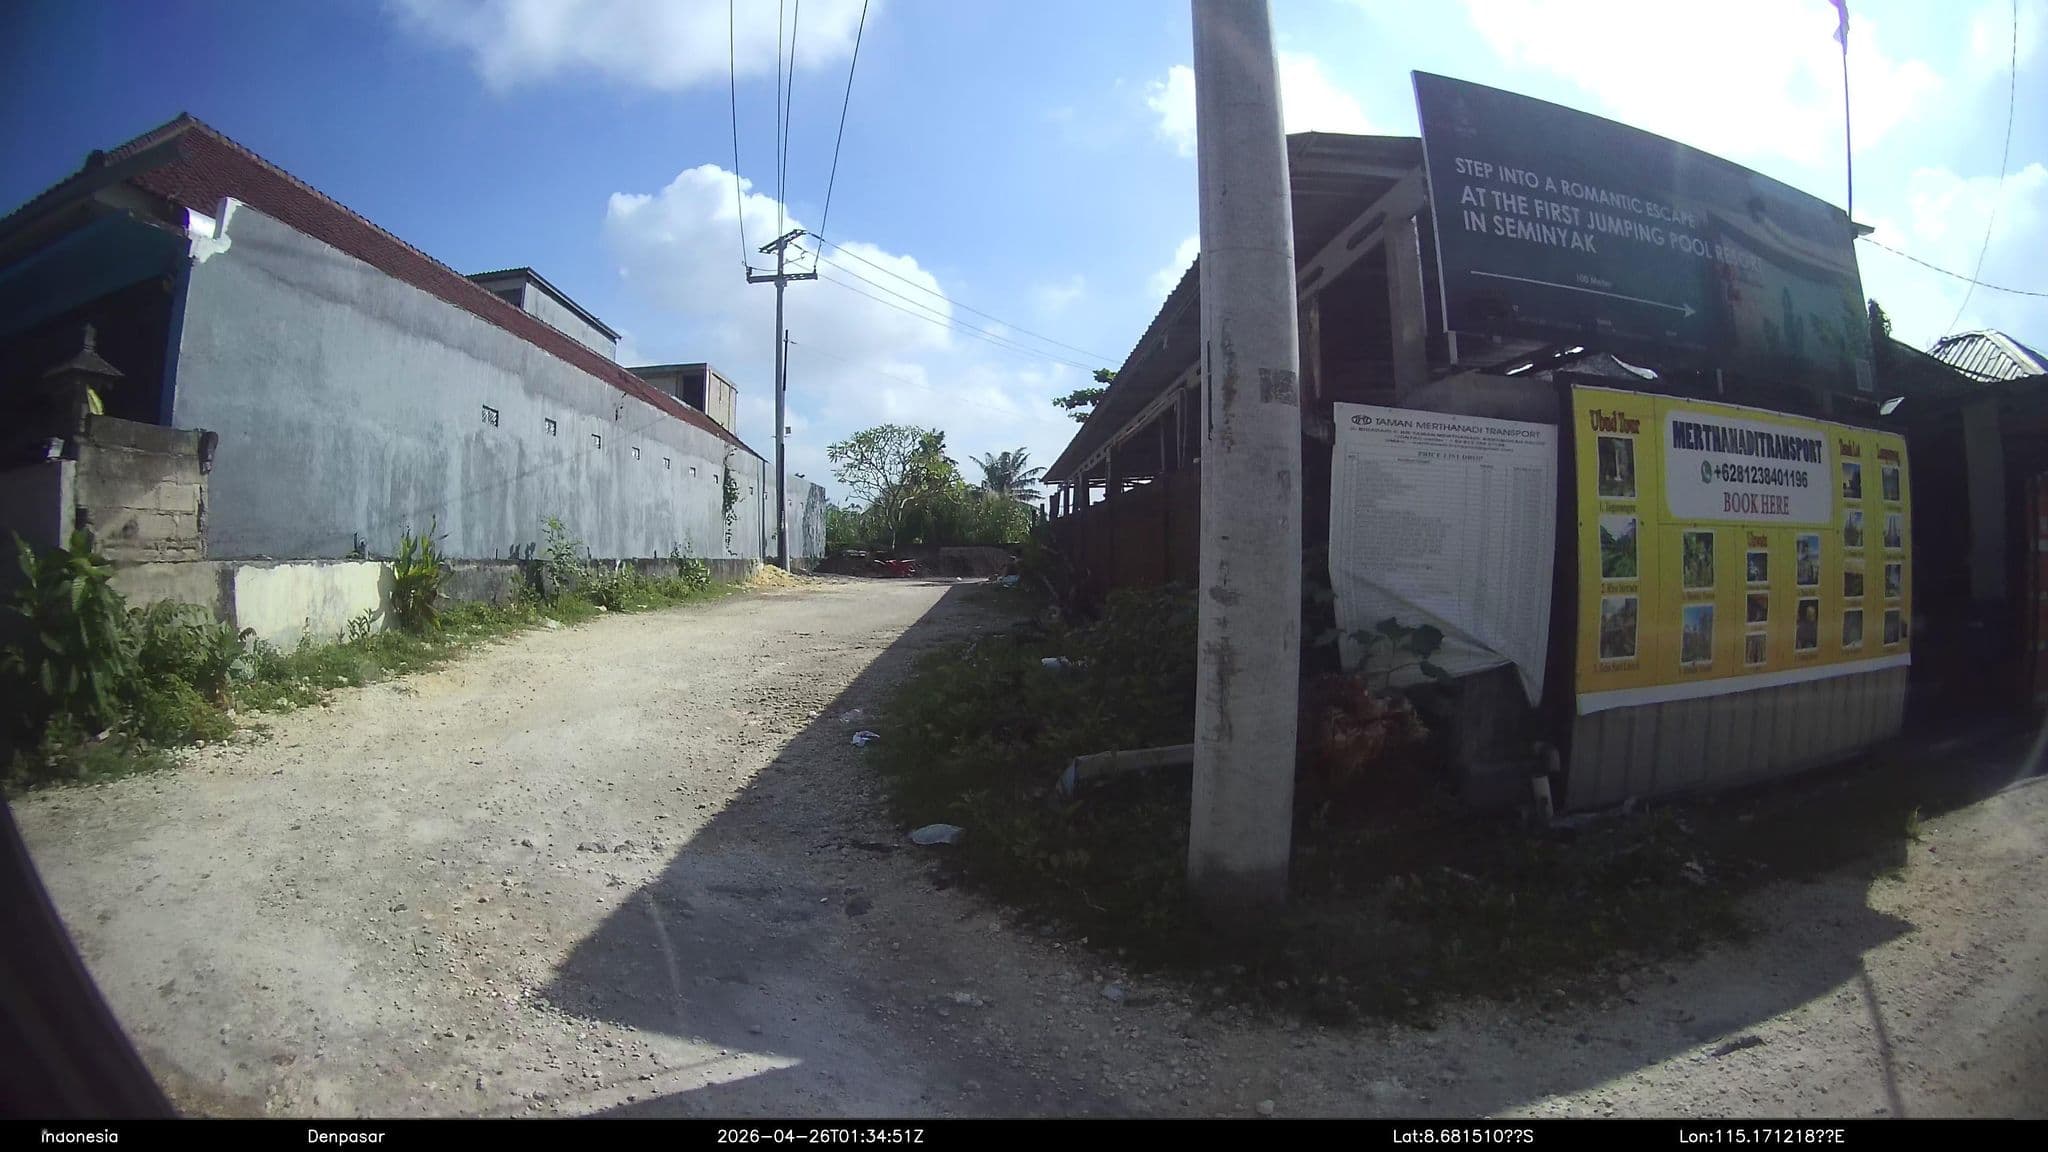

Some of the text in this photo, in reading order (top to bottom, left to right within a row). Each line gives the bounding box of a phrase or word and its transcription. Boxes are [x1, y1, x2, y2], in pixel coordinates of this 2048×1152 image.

[1455, 157, 1696, 229] STEP INTO A ROMANTIC ESCAPE
[1461, 185, 1486, 207] AT
[1491, 190, 1529, 215] THE
[1534, 198, 1580, 226] FIRST
[1587, 211, 1665, 246] JUMPING
[1669, 231, 1713, 259] POOL
[1463, 210, 1597, 253] IN SEMINYAK
[1375, 417, 1413, 428] TAMAN
[1415, 421, 1483, 434] MERTHANADI
[1485, 426, 1541, 438] TRANSPORT
[1672, 420, 1823, 464] MERTHANADITRANSPORT
[1714, 463, 1808, 488] +6281238401196
[1723, 491, 1789, 515] BOOK HERE
